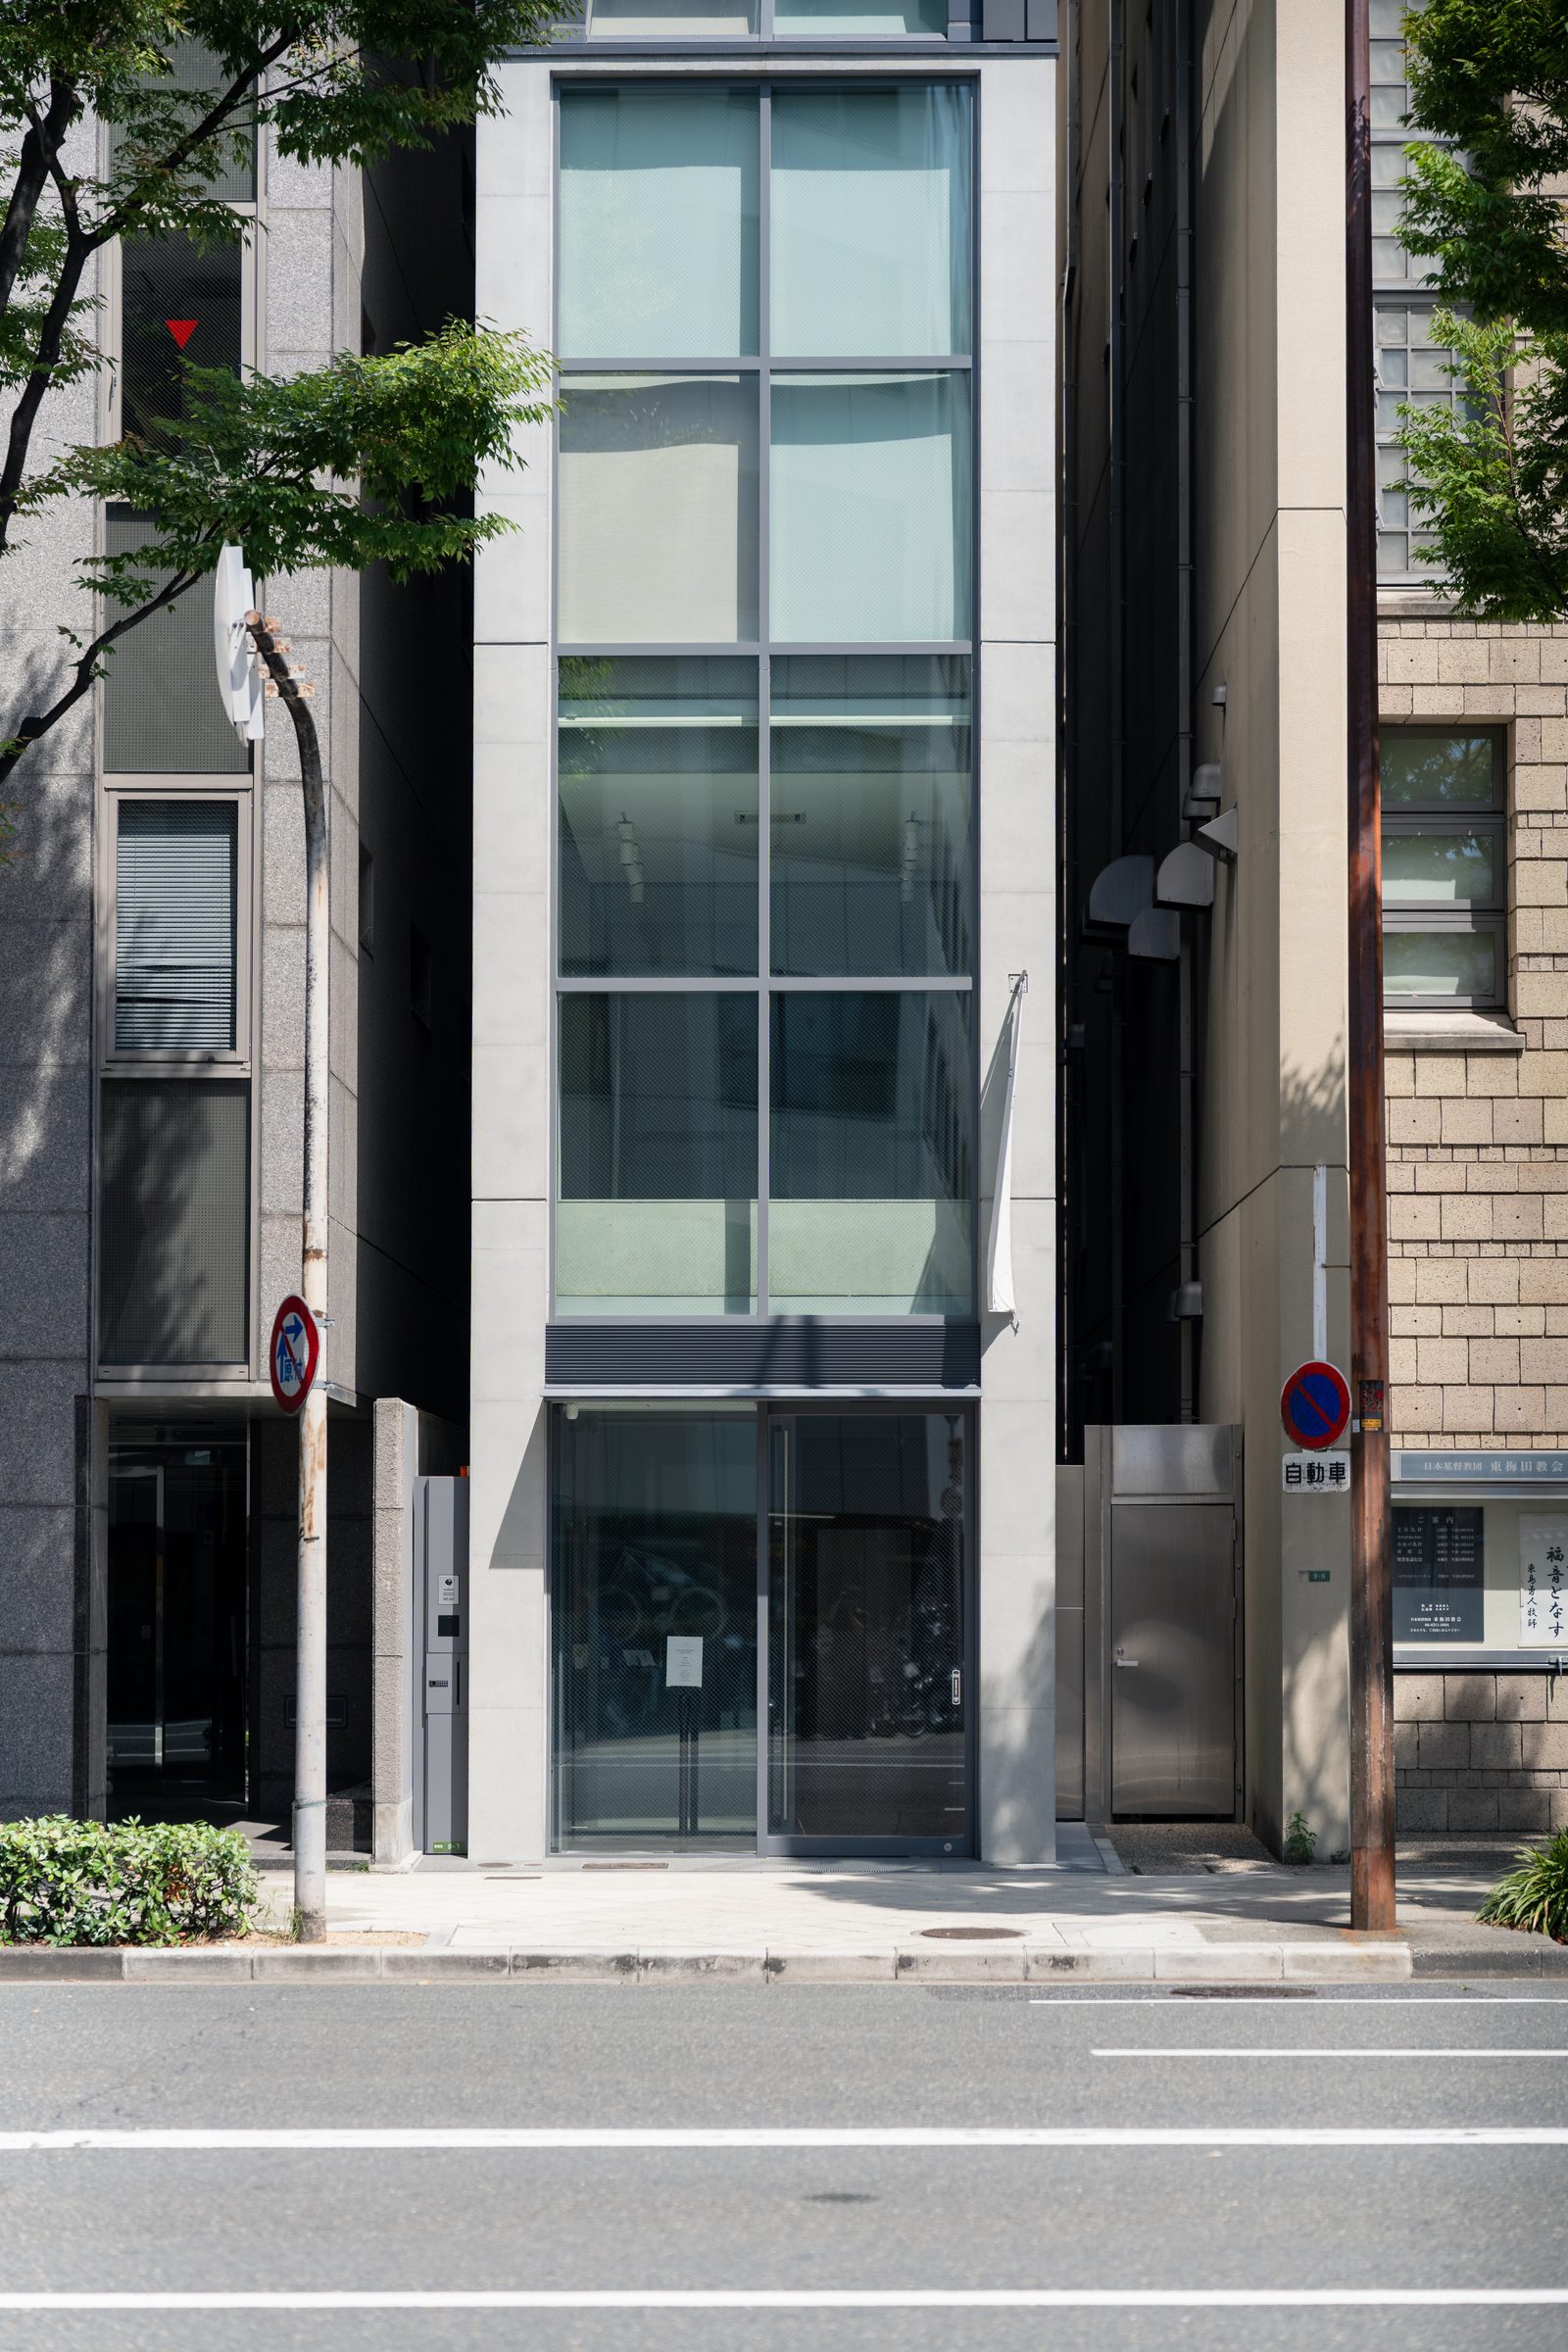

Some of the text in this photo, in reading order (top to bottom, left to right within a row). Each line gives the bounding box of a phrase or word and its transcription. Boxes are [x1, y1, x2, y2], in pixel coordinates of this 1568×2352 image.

[1285, 1461, 1347, 1484] 自動車
[1424, 1460, 1564, 1472] 日本基督教団 東梅田教会
[1546, 1546, 1564, 1638] 福音となす
